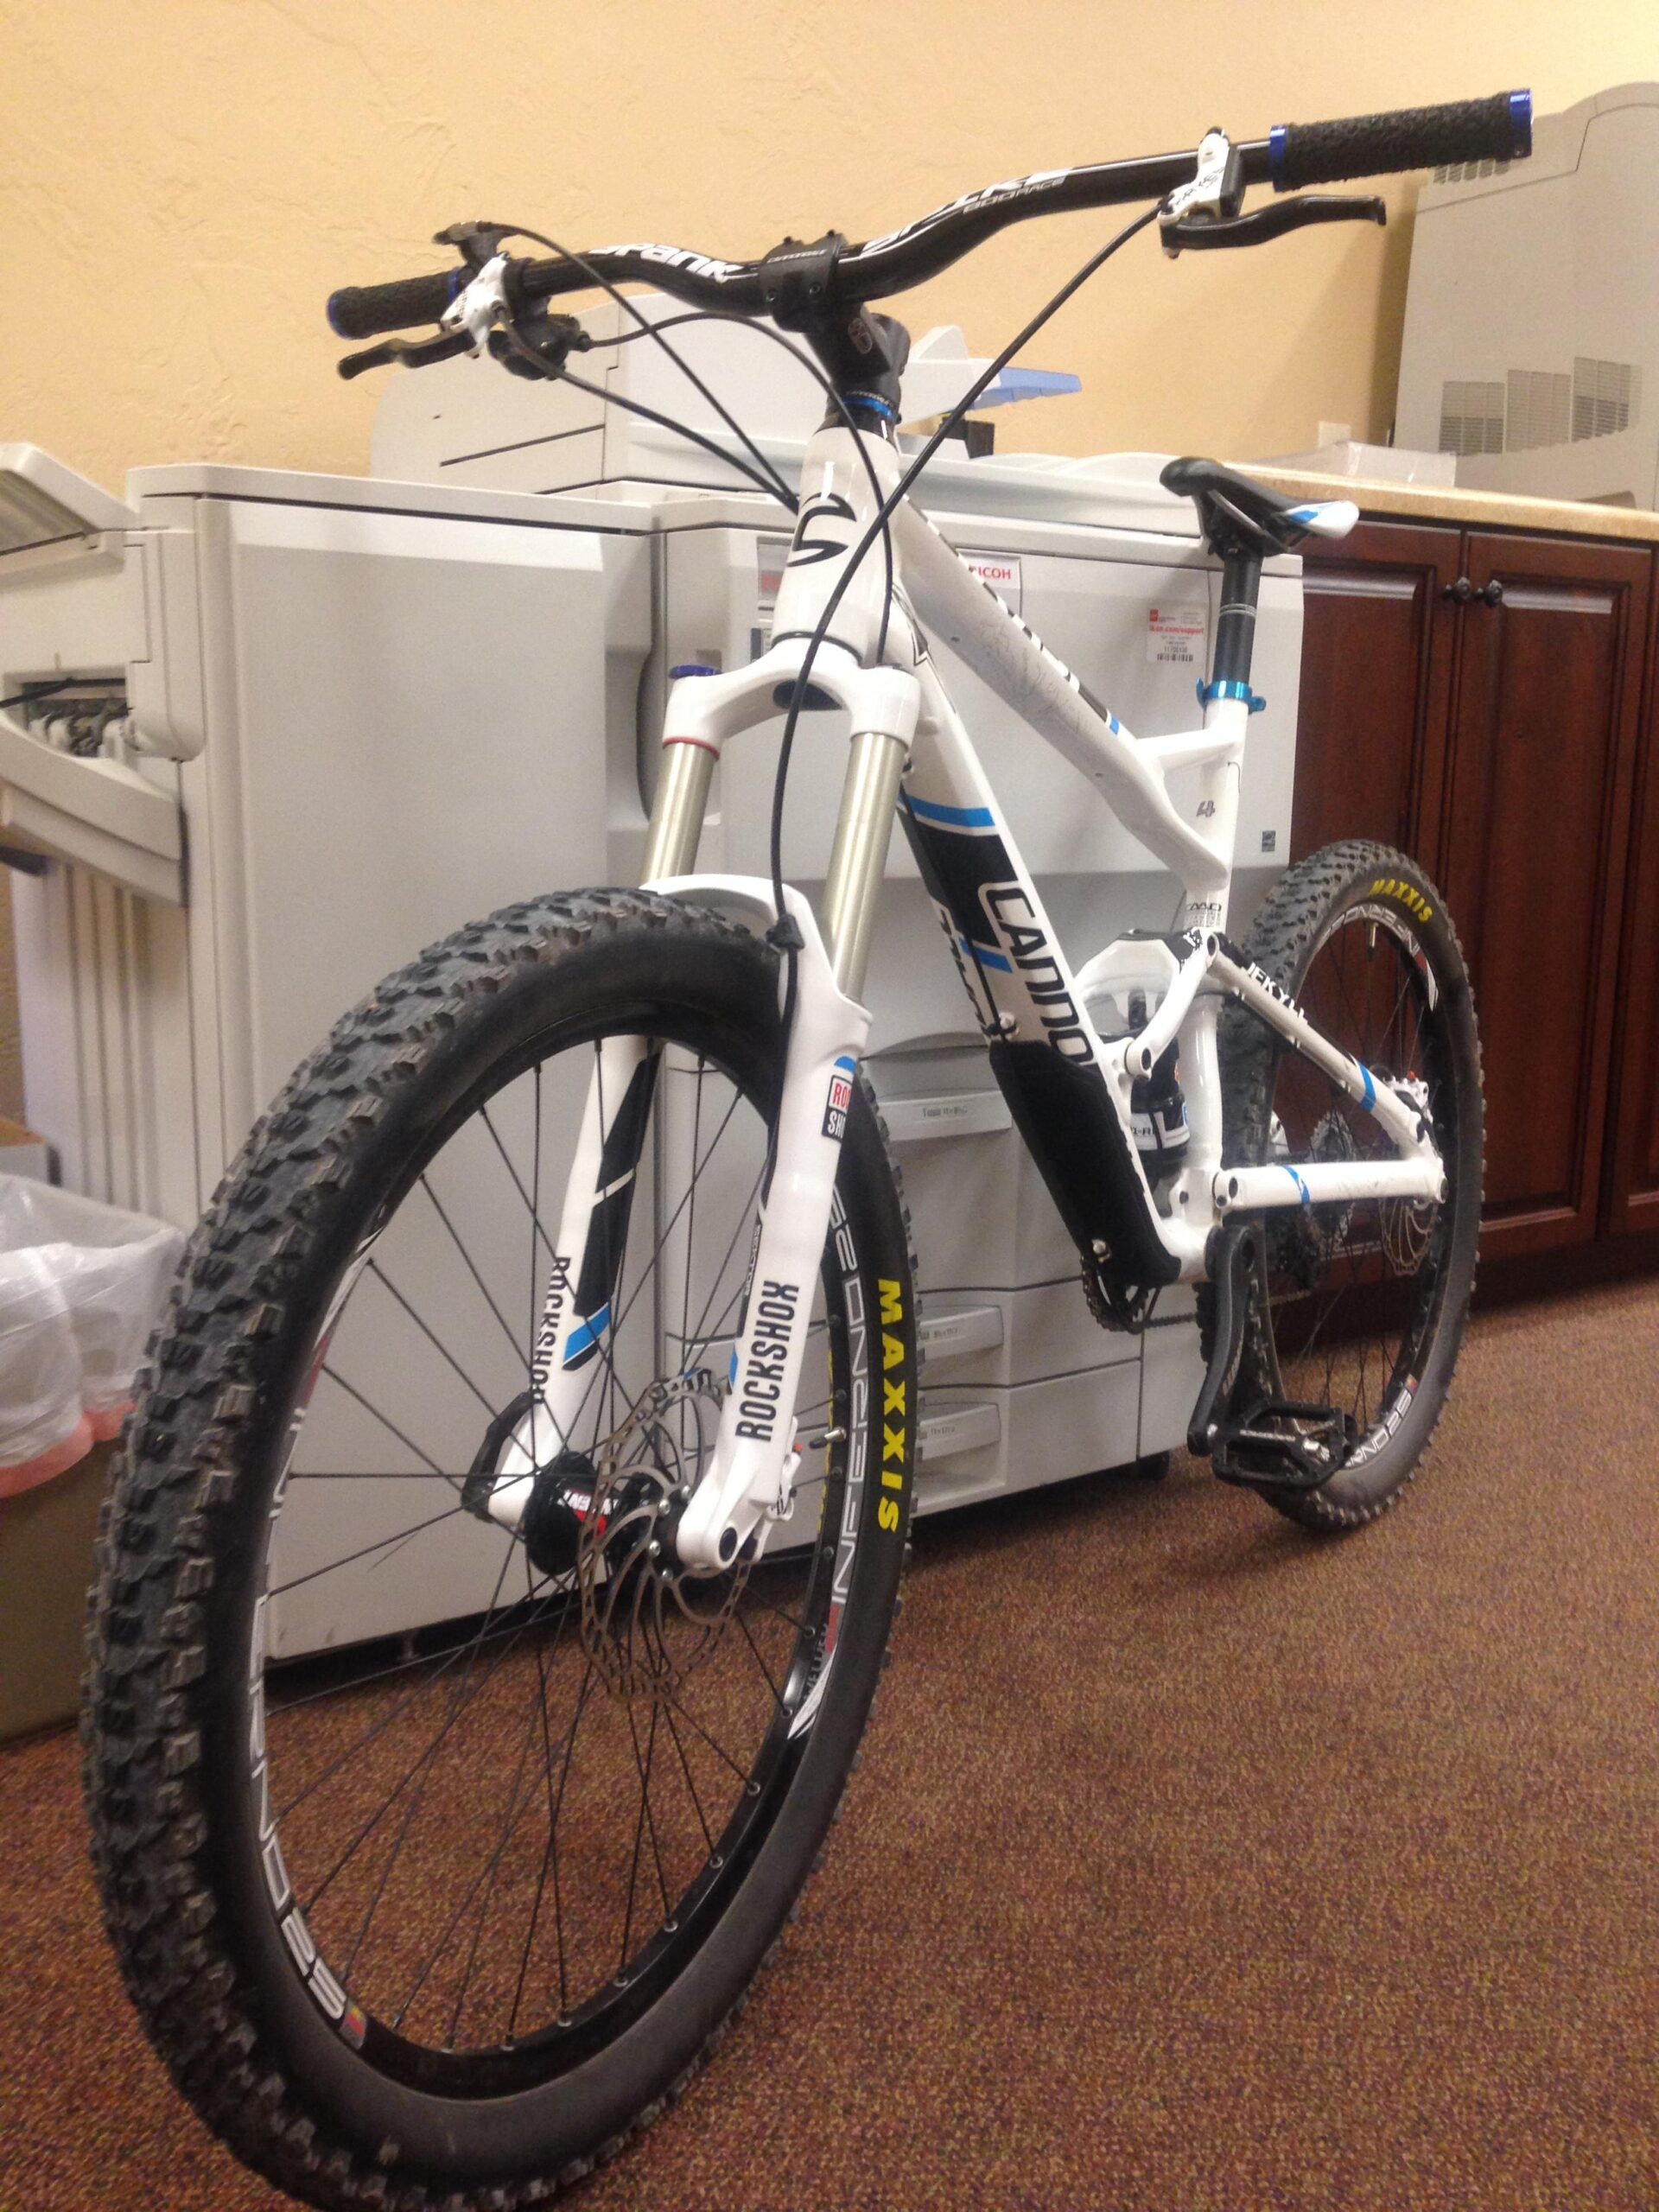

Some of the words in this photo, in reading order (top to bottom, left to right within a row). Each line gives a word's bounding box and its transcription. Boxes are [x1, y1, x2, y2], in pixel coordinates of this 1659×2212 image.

[986, 888, 1097, 1066] CANNO
[1369, 879, 1433, 923] MAXXIS
[827, 1110, 847, 1139] SH
[735, 1281, 799, 1442] ROCKSHOX
[831, 1275, 868, 1605] INFERNO
[878, 1279, 906, 1533] MAXXIS
